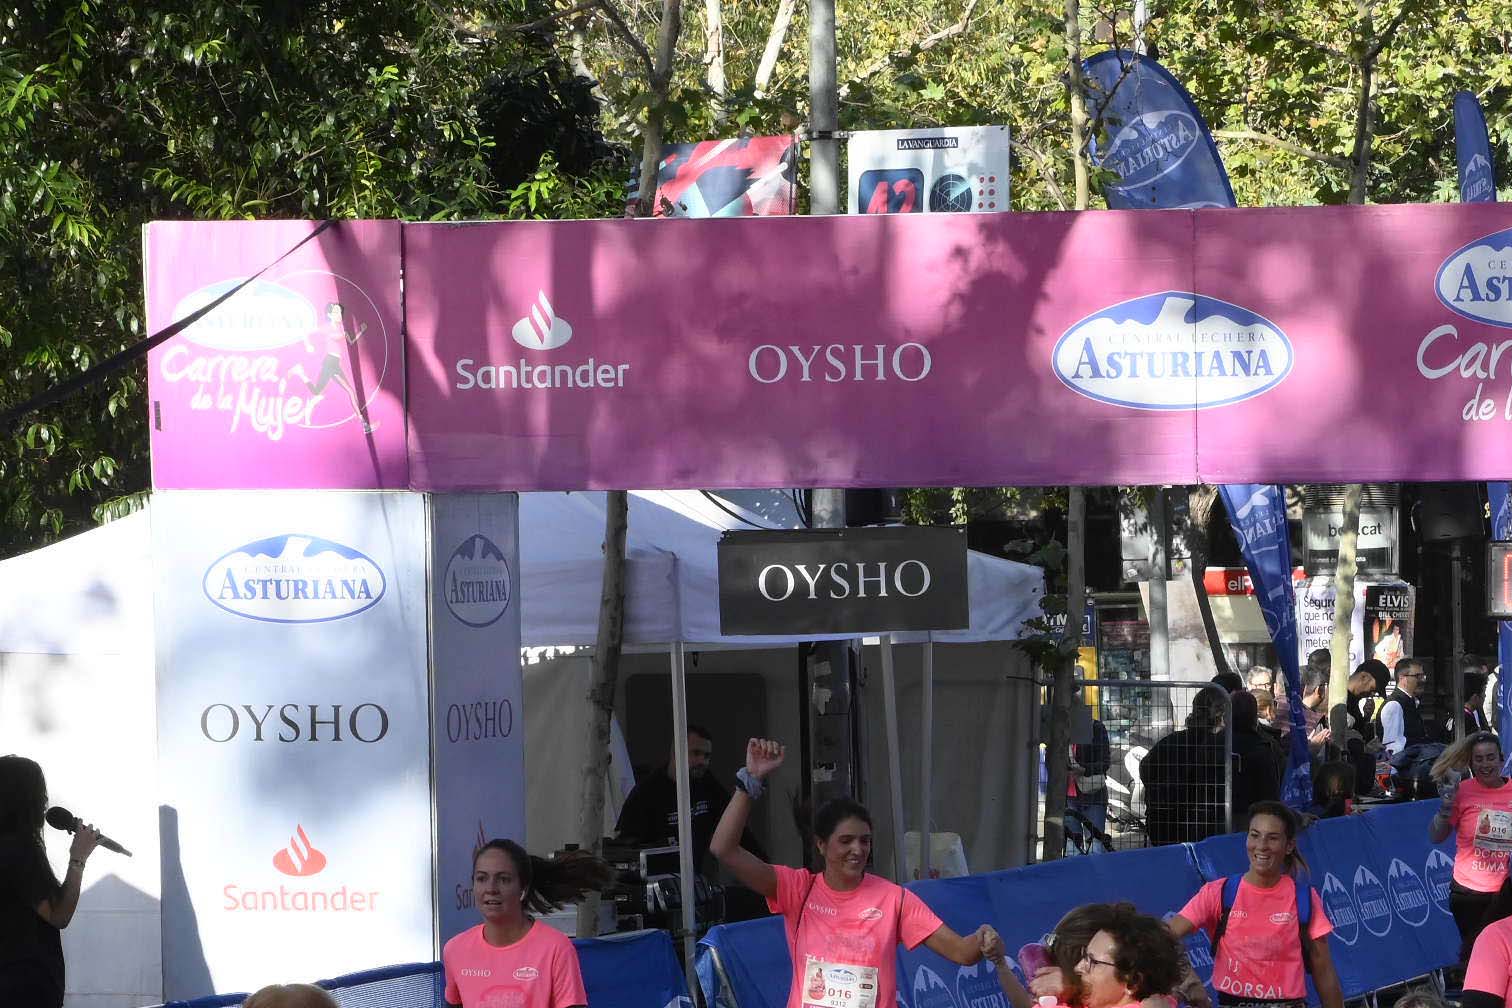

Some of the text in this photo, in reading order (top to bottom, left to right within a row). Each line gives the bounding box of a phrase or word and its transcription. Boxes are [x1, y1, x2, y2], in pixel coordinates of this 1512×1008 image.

[1108, 331, 1266, 345] CENTRAL LECHERA
[160, 346, 281, 384] Carrera
[456, 358, 630, 390] Santander
[748, 342, 932, 384] OYSHO
[1071, 336, 1275, 379] ASTURIANA
[230, 377, 325, 441] Mujer
[1462, 382, 1497, 421] de
[218, 566, 374, 601] ASTURIANA
[450, 572, 507, 604] ASTURIANA
[758, 559, 932, 601] OYSHO
[1378, 594, 1409, 607] ELVIS
[200, 702, 389, 743] OYSHO
[446, 698, 512, 744] OYSHO
[1471, 860, 1505, 872] SUMA
[222, 883, 379, 912] Santander
[828, 987, 852, 1000] 016
